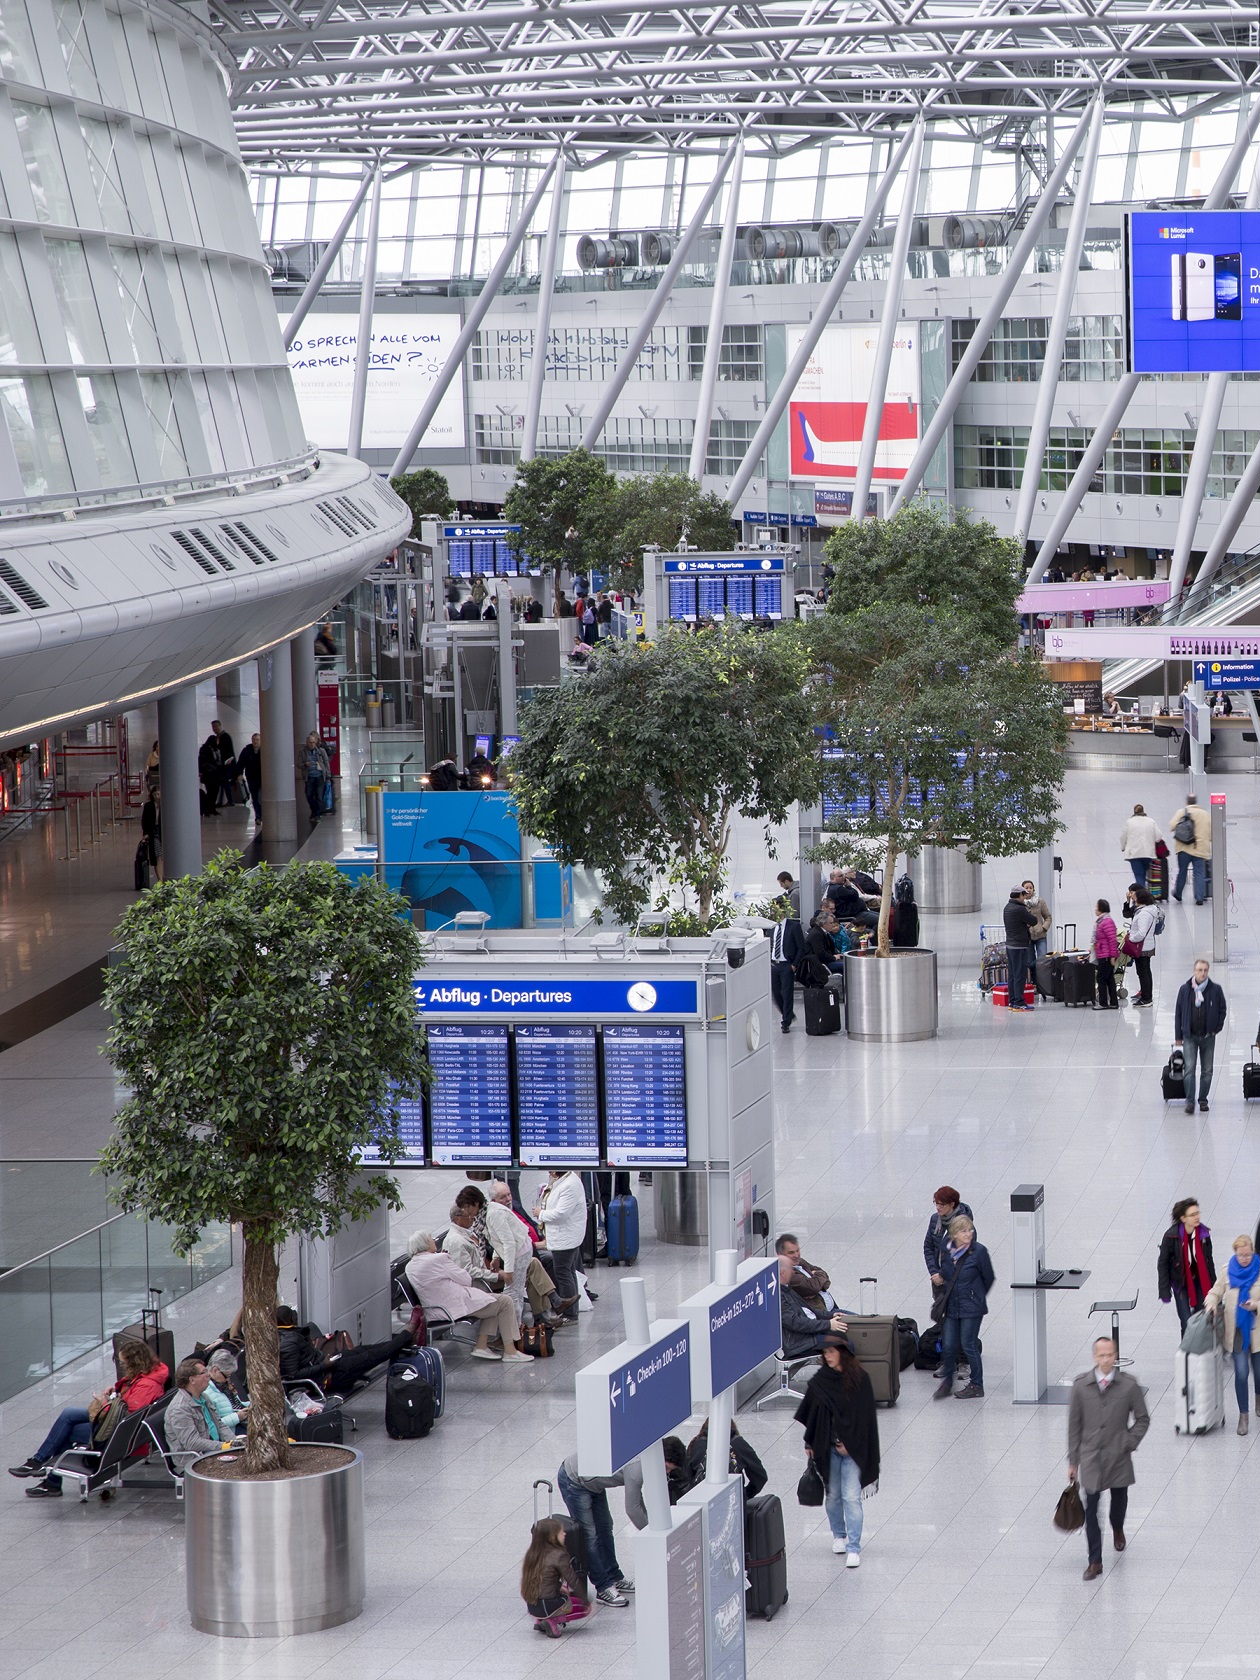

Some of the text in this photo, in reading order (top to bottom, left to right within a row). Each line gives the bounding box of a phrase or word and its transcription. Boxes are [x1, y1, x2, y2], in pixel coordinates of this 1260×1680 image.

[380, 334, 408, 344] ALLE
[412, 334, 441, 344] VOM
[430, 988, 572, 1006] Abflug Departures
[710, 1306, 732, 1332] Check-in
[637, 1356, 662, 1384] Check-in
